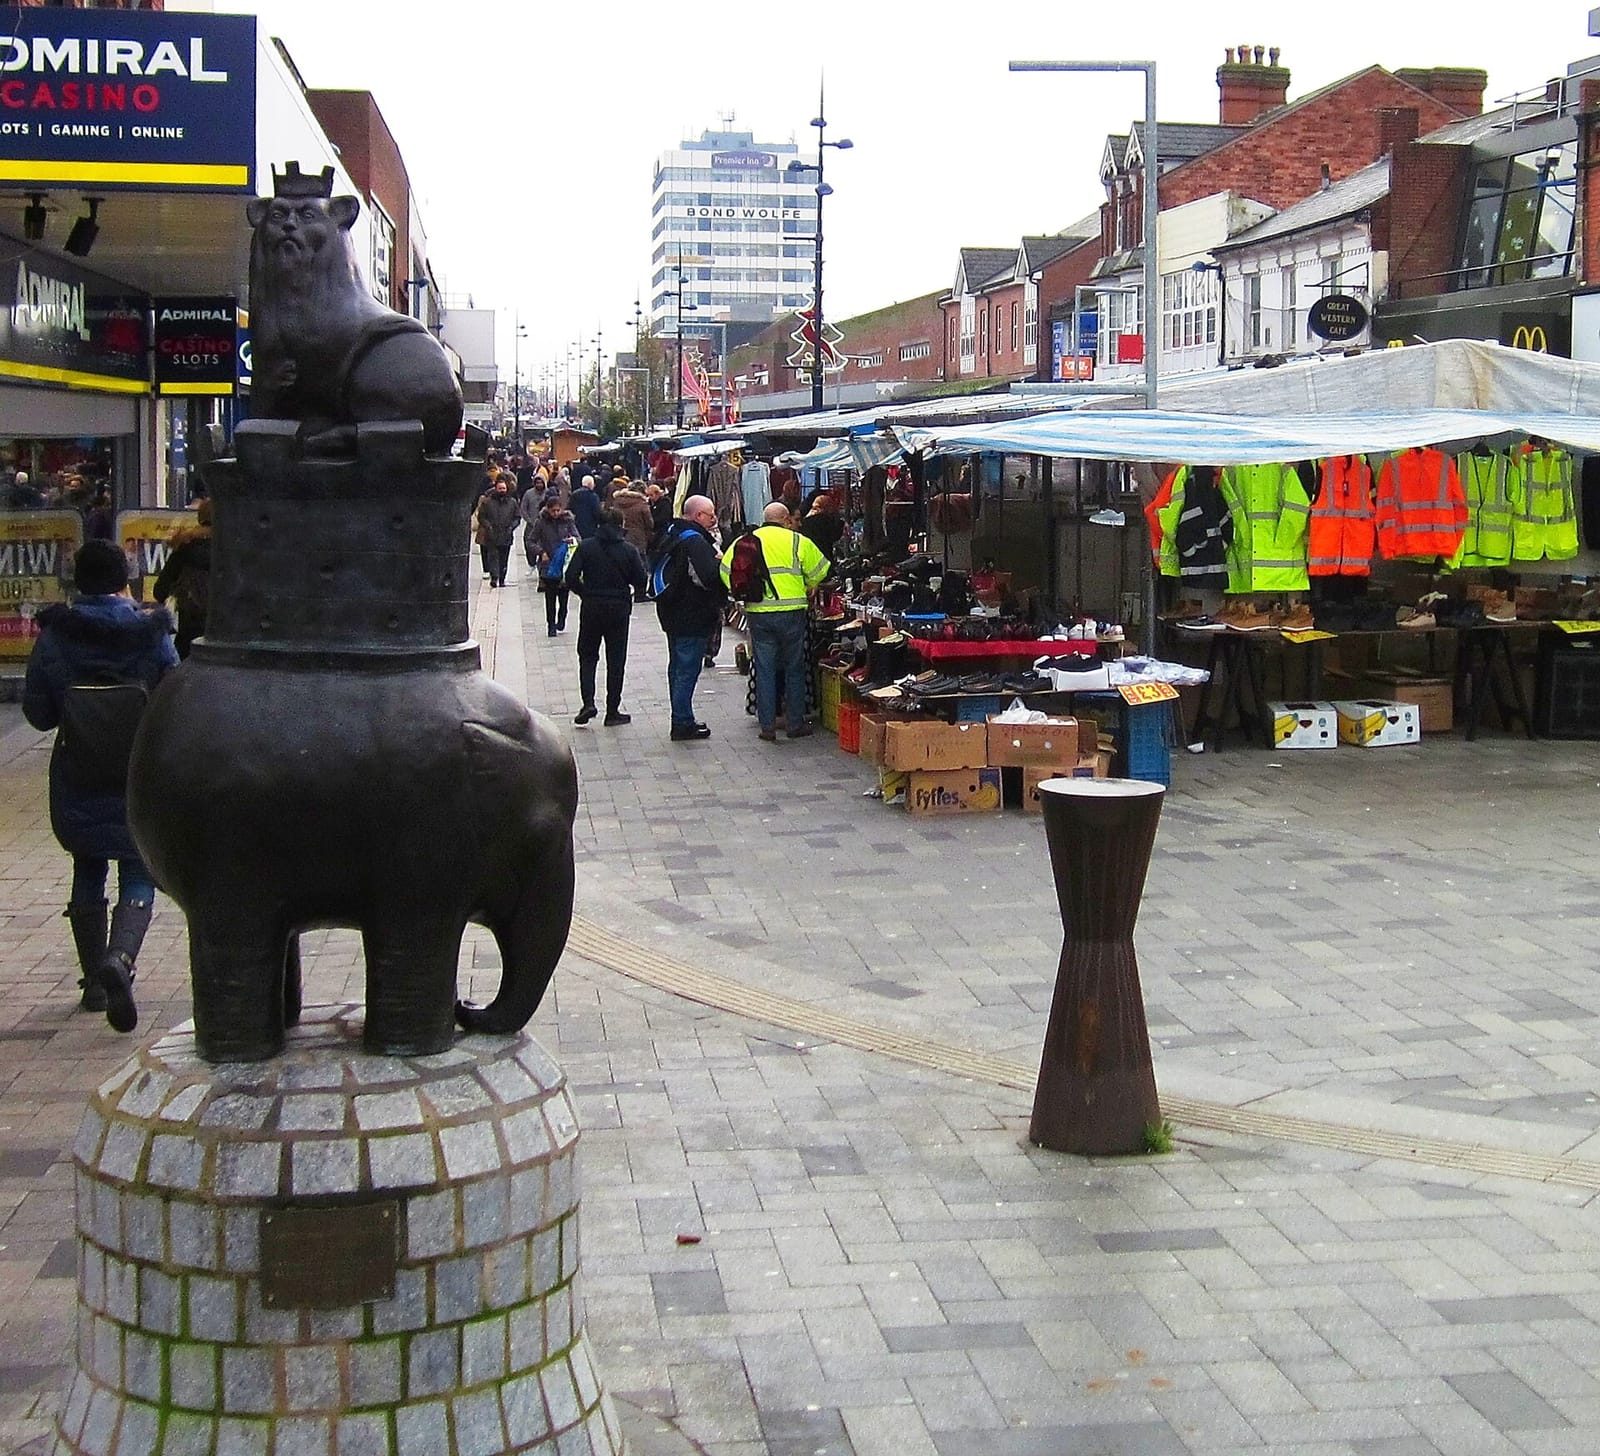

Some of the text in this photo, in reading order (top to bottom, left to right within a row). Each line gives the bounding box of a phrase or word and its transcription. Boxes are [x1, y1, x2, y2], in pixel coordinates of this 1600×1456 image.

[1, 80, 160, 112] CASINO
[0, 123, 183, 138] OTS GAMING ONLINE
[714, 155, 760, 166] Premier Inn
[687, 207, 801, 219] BOND WOLFE
[1326, 302, 1350, 312] GREAT
[160, 308, 232, 323] ADMIRAL
[1320, 313, 1356, 324] WESTERN
[159, 339, 231, 352] CASINO
[173, 353, 219, 365] SLOTS
[1136, 684, 1161, 700] £3
[916, 787, 959, 809] fyffes
